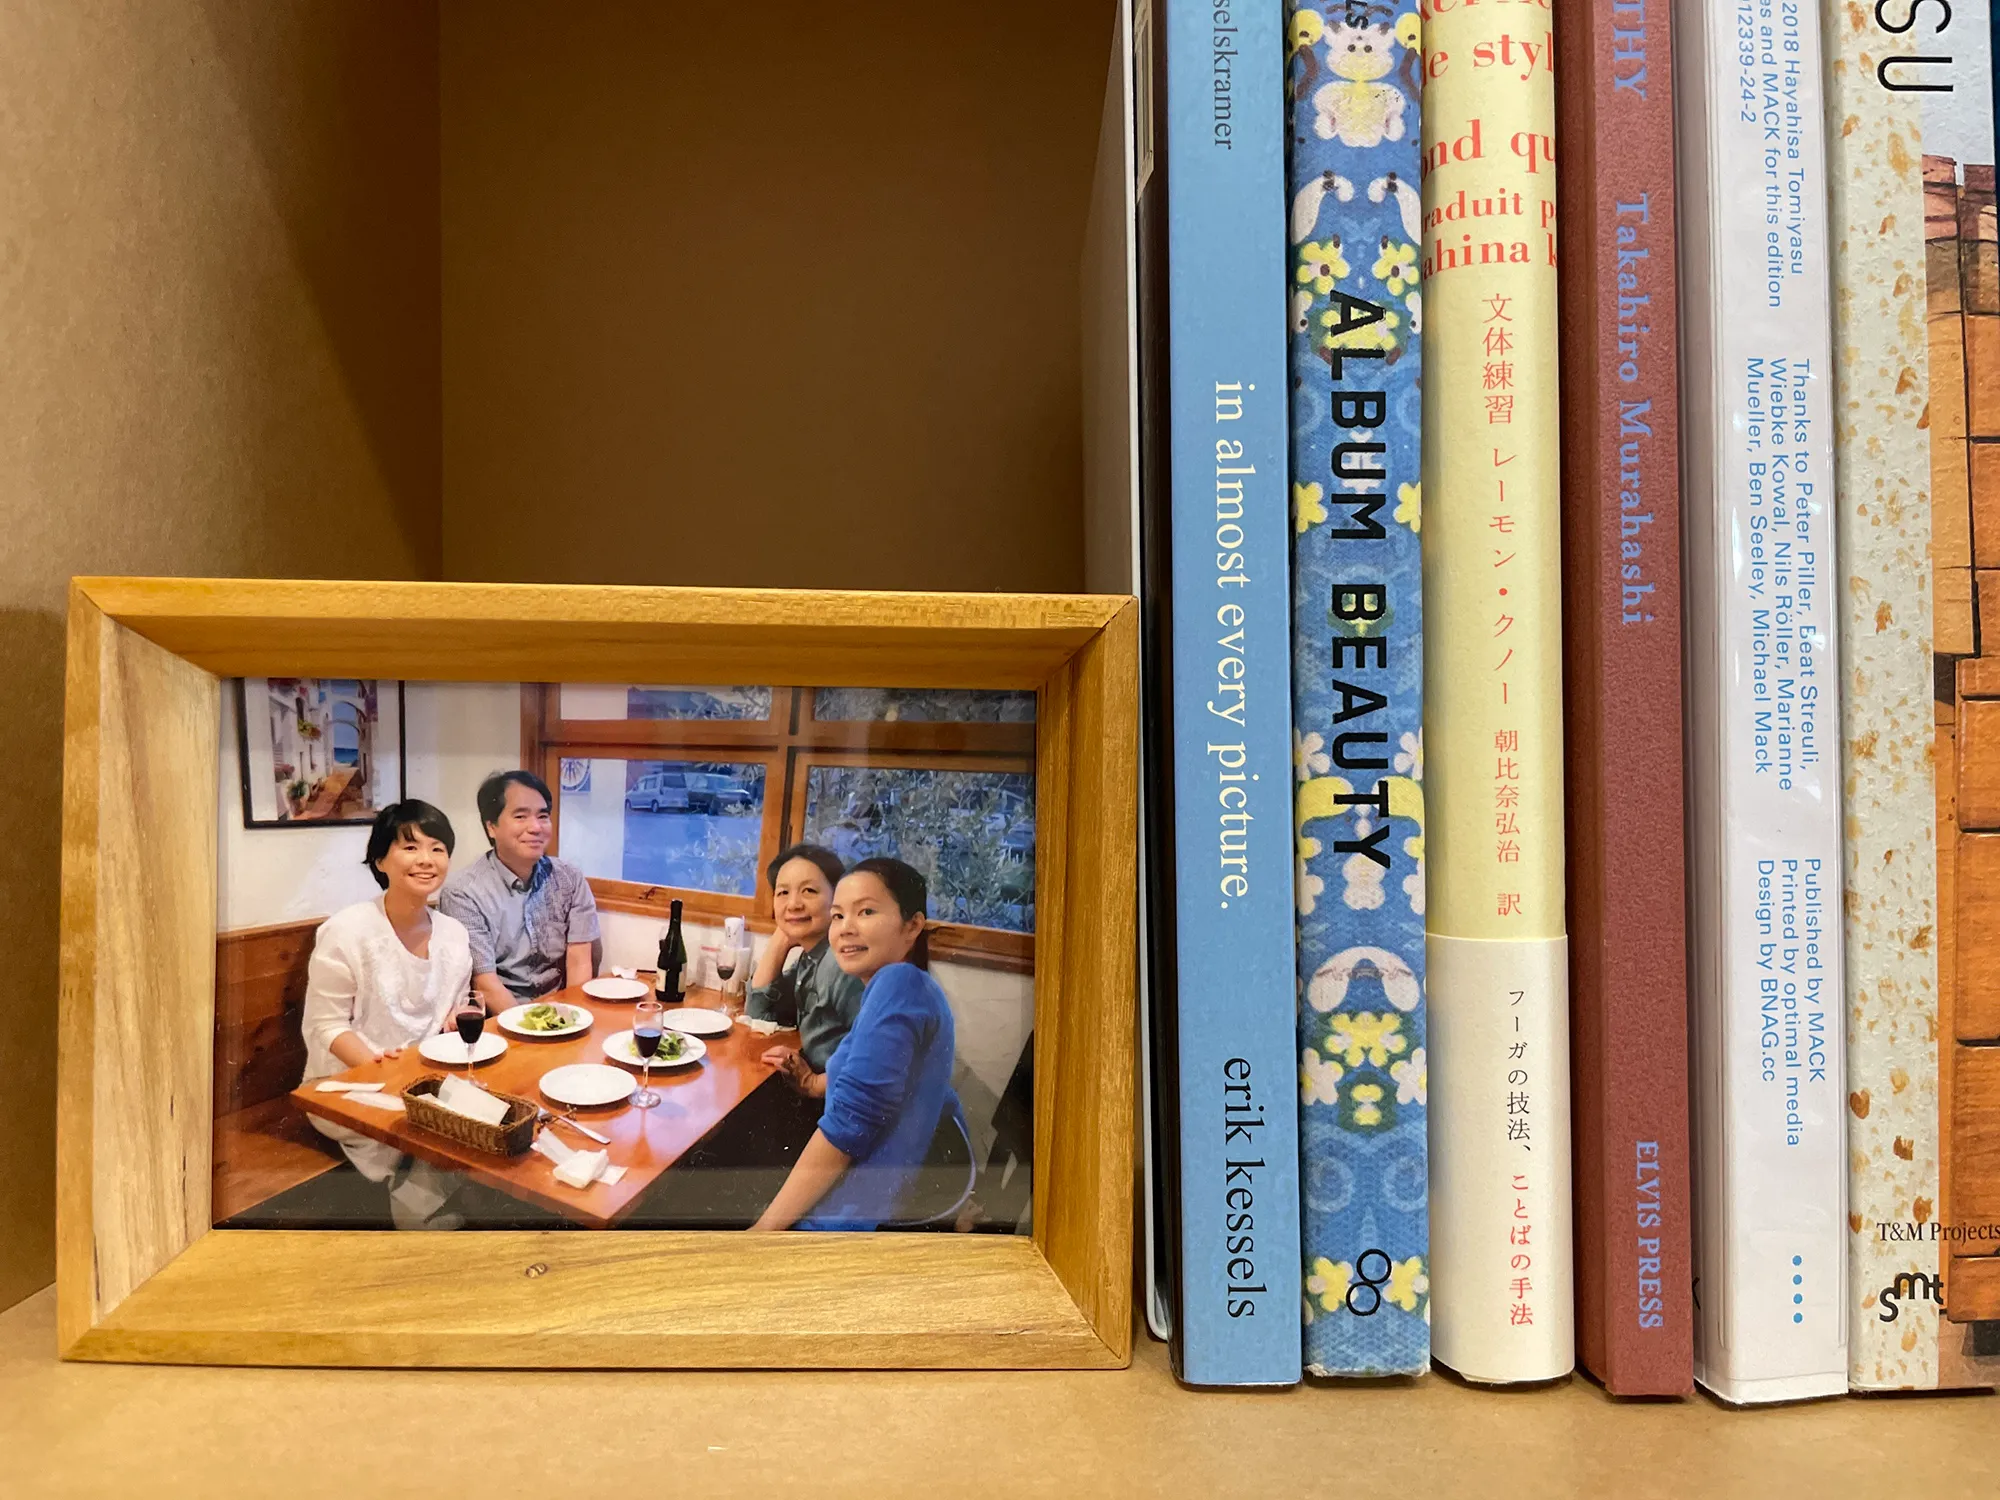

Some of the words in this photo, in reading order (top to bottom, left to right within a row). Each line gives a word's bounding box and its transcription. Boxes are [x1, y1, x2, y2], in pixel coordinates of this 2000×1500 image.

[1738, 0, 1756, 123] 12339-24-2
[1760, 26, 1777, 65] and
[1782, 2, 1799, 52] 2018
[1763, 73, 1781, 140] MACK
[1783, 60, 1803, 159] Hayahisa
[1765, 148, 1780, 178] for
[1766, 184, 1782, 224] this
[1786, 168, 1805, 274] Tomiyasu
[1616, 192, 1650, 382] Takahiro
[1767, 232, 1784, 307] edition
[1482, 293, 1514, 424] 文体練習
[1793, 358, 1811, 443] Thanks
[1215, 380, 1256, 424] in
[1330, 290, 1386, 539] ALBUM
[1747, 358, 1765, 452] Mueller,
[1770, 358, 1788, 445] Wiebke
[1749, 463, 1766, 506] Ben
[1771, 455, 1790, 532] Kowal,
[1795, 451, 1809, 473] to
[1215, 438, 1256, 588] almost
[1620, 399, 1655, 624] Murahashi
[1796, 483, 1813, 543] Peter
[1748, 515, 1768, 600] Seeley,
[1774, 542, 1791, 586] Nils
[1797, 552, 1815, 615] Piller,
[1207, 604, 1246, 727] every
[1753, 610, 1771, 701] Michael
[1775, 595, 1793, 669] Röller,
[1799, 625, 1816, 677] Beat
[1331, 584, 1391, 869] BEAUTY
[1755, 712, 1773, 774] Mack
[1777, 679, 1796, 791] Marianne
[1800, 685, 1819, 770] Streuli,
[1207, 741, 1259, 909] picture.
[1494, 729, 1521, 863] 朝比奈弘治
[1497, 893, 1522, 916] 訳
[1755, 860, 1775, 935] Design
[1781, 859, 1799, 939] Printed
[1805, 858, 1824, 969] Published
[1757, 944, 1777, 970] by
[1780, 948, 1799, 974] by
[1804, 978, 1824, 1004] by
[1760, 979, 1779, 1082] BNAG.cc
[1781, 982, 1802, 1067] optimal
[1808, 1012, 1826, 1083] MACK
[1224, 1057, 1265, 1145] erik
[1786, 1077, 1803, 1146] media
[1636, 1141, 1661, 1229] ELVIS
[1226, 1157, 1268, 1318] kessels
[1876, 1222, 1924, 1241] T&M
[1930, 1222, 2000, 1246] Projects
[1638, 1237, 1663, 1329] PRESS
